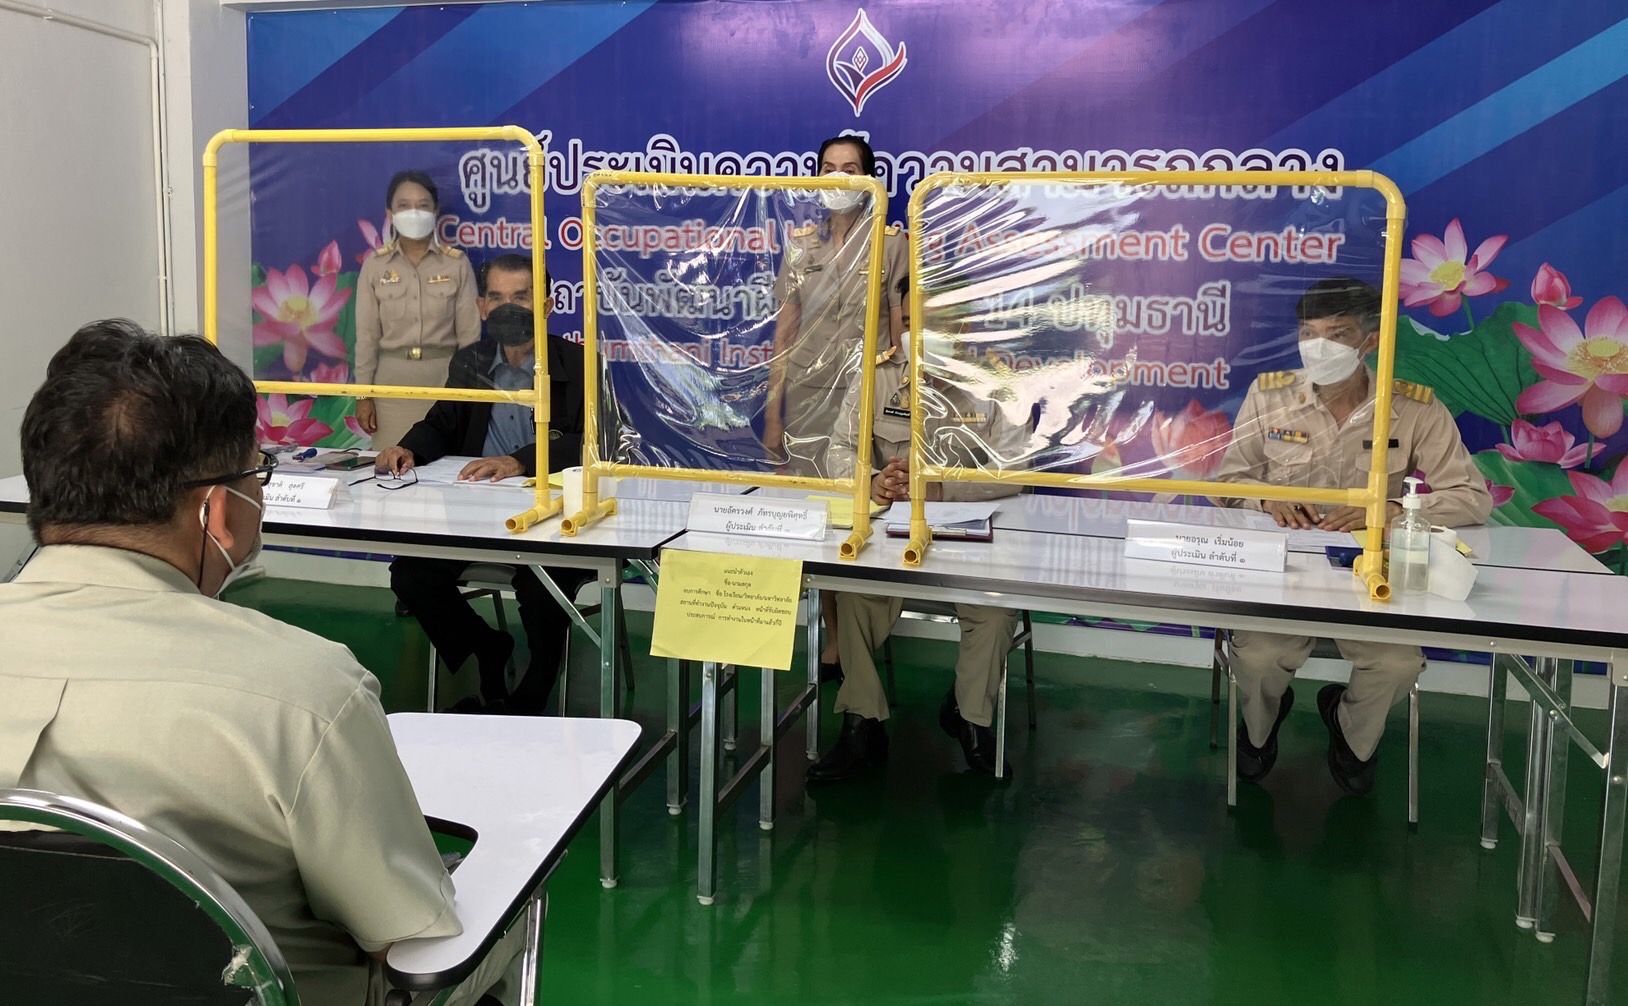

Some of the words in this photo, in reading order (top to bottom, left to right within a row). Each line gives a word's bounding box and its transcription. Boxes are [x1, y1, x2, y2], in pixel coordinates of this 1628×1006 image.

[436, 215, 551, 250] Centra
[1198, 223, 1345, 264] Center
[1049, 280, 1231, 349] ปทุมธานี
[992, 347, 1231, 390] Devopment
[725, 520, 756, 532] ผู้ประเมิน
[1214, 534, 1244, 548] เริ่มน้อย
[1209, 551, 1237, 563] ลำดับที่
